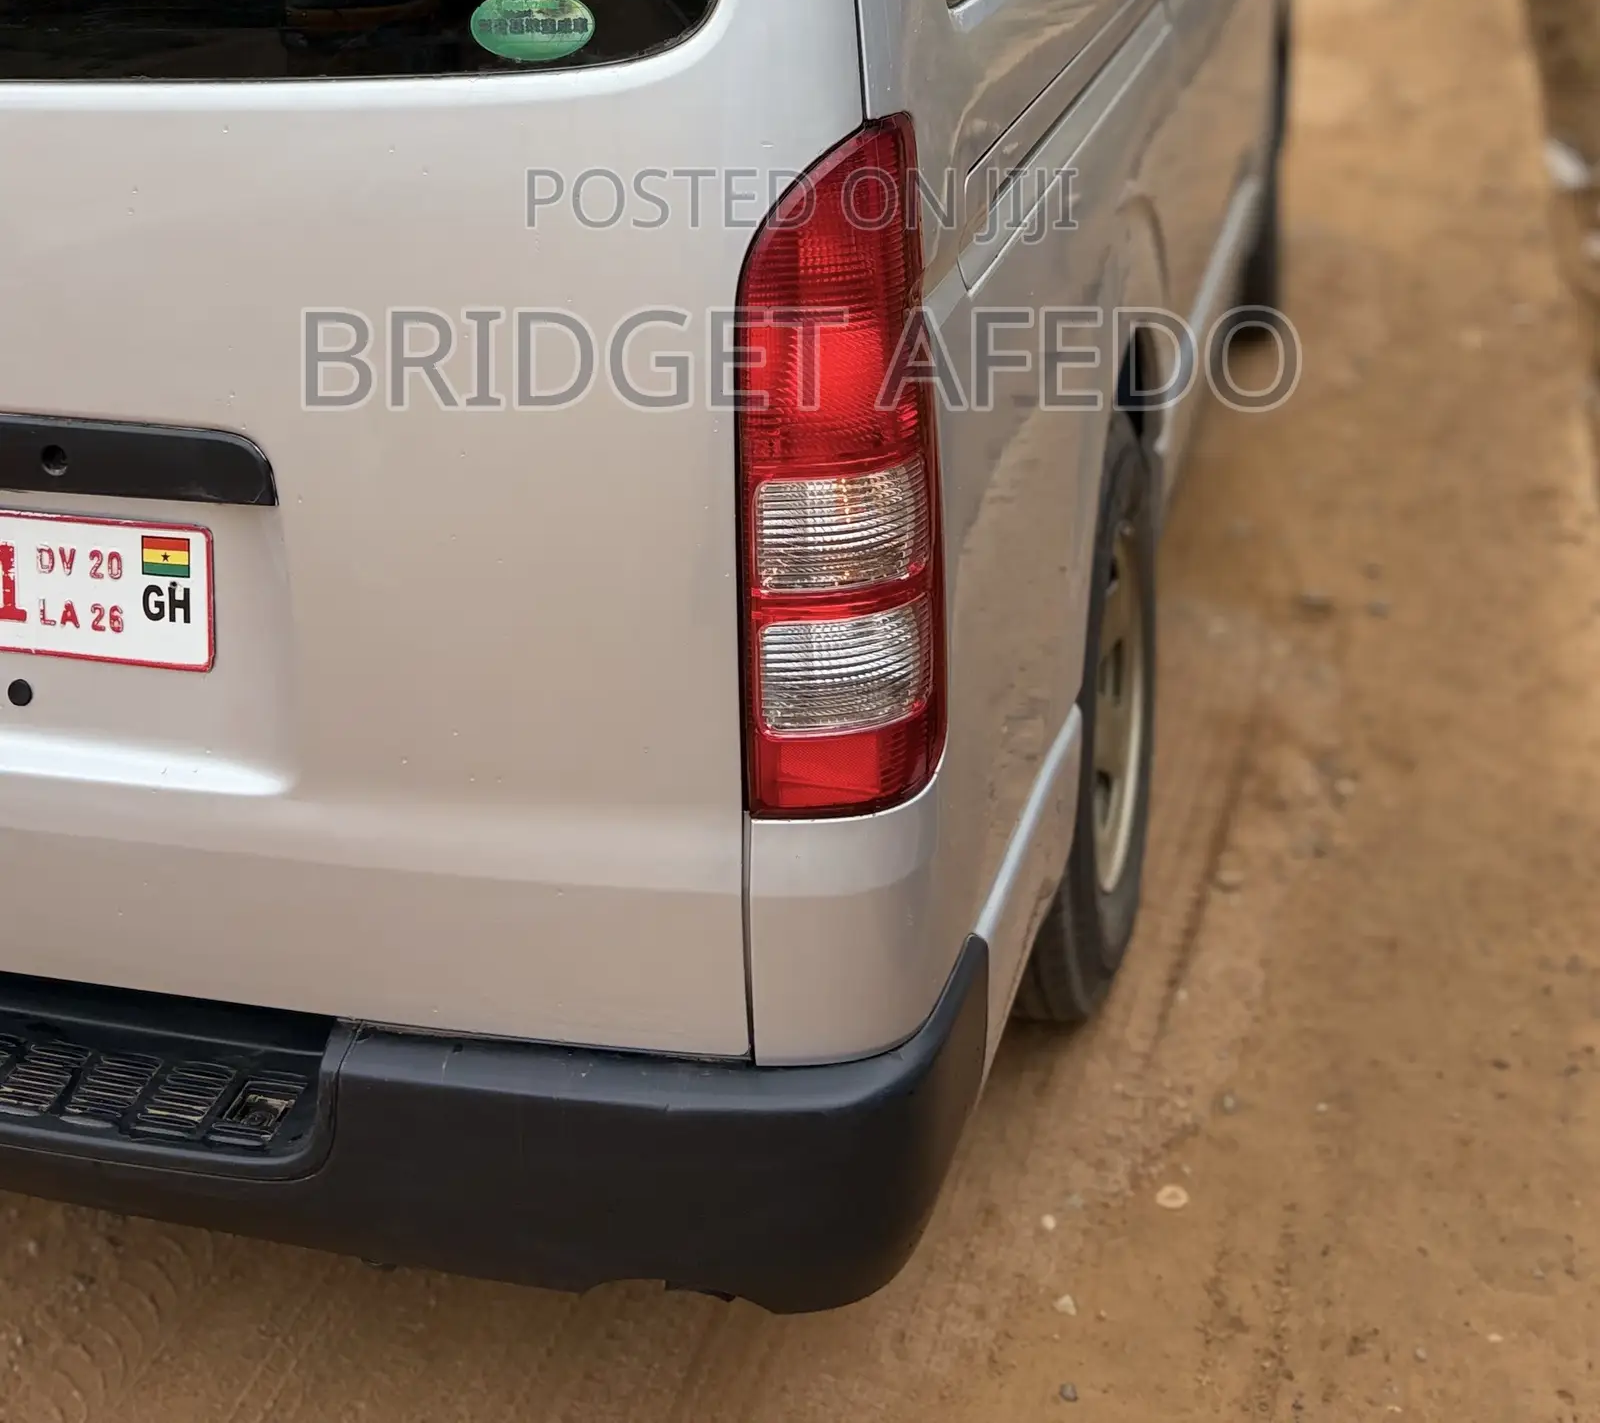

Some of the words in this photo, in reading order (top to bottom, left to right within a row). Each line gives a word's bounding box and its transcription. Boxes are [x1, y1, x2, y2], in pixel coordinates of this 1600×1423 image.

[36, 544, 77, 576] DV
[88, 548, 124, 580] 20
[38, 598, 81, 629] LA
[90, 603, 125, 634] 26
[142, 583, 191, 624] GH
